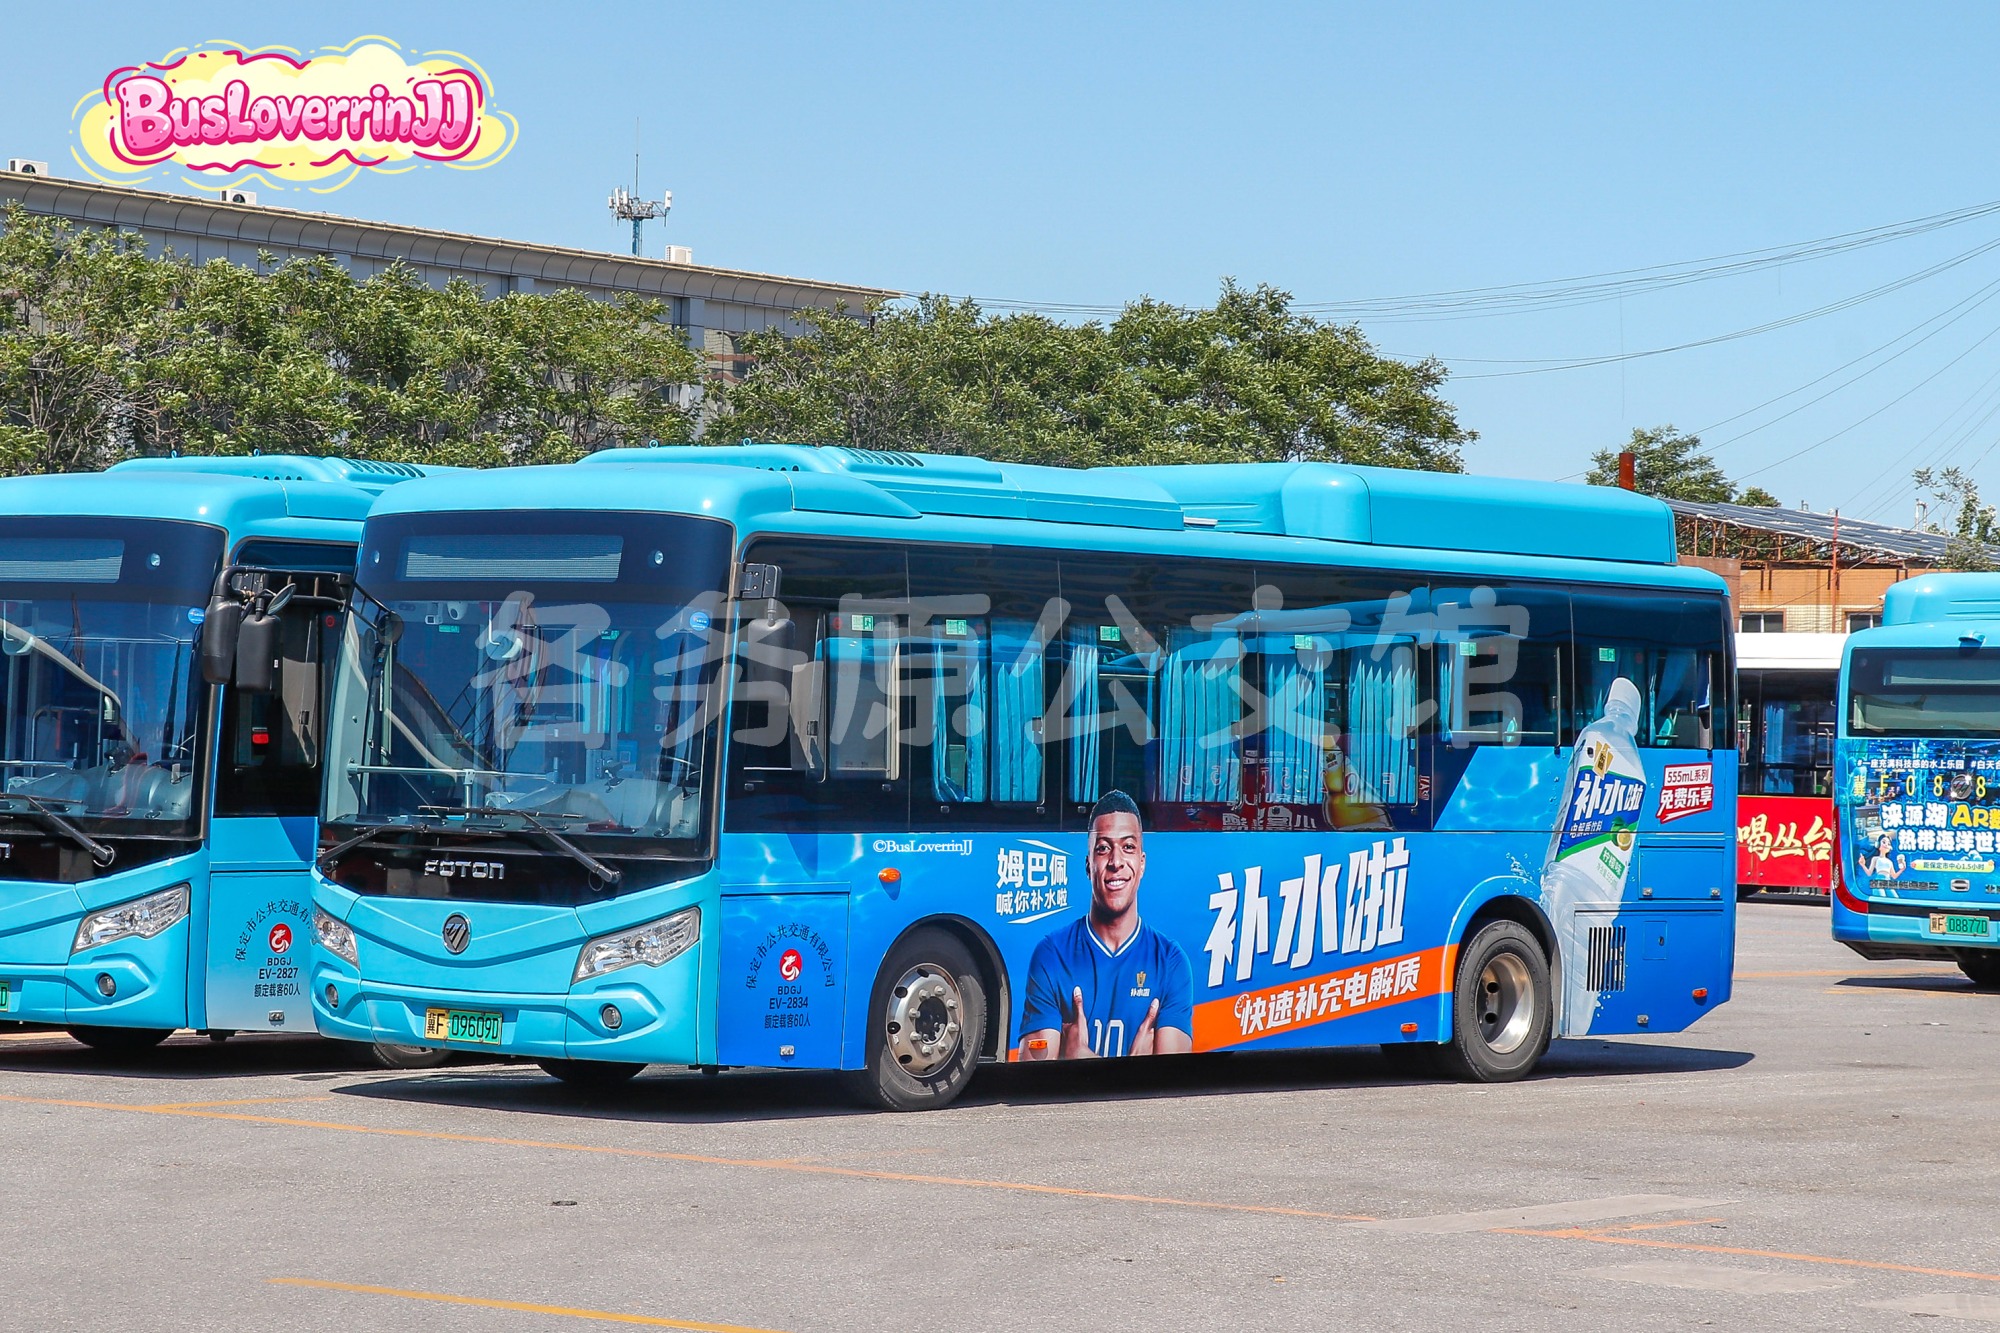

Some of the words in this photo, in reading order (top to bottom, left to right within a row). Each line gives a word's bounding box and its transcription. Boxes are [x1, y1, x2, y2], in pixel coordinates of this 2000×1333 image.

[1667, 767, 1709, 785] 555mL系列
[1573, 771, 1644, 821] 补水啦
[1659, 786, 1713, 811] 免费乐享
[1881, 802, 1948, 829] 涞源湖
[424, 859, 505, 880] FOTON
[996, 847, 1068, 889] 姆巴佩
[996, 888, 1068, 916] 喊你补水啦
[1204, 836, 1410, 988] 补水啦
[235, 899, 311, 962] 保定市公共交通有
[266, 957, 292, 967] BDGJ
[746, 922, 836, 990] 保定市公共交通有限公司
[258, 967, 299, 980] EV-2827
[254, 982, 301, 998] 额定载客60人
[769, 996, 809, 1010] EV-2834
[777, 985, 802, 995] BDGJ
[1238, 956, 1422, 1037] 快速补充电解质
[764, 1013, 811, 1029] 额定载客60人
[1094, 1018, 1125, 1058] 10
